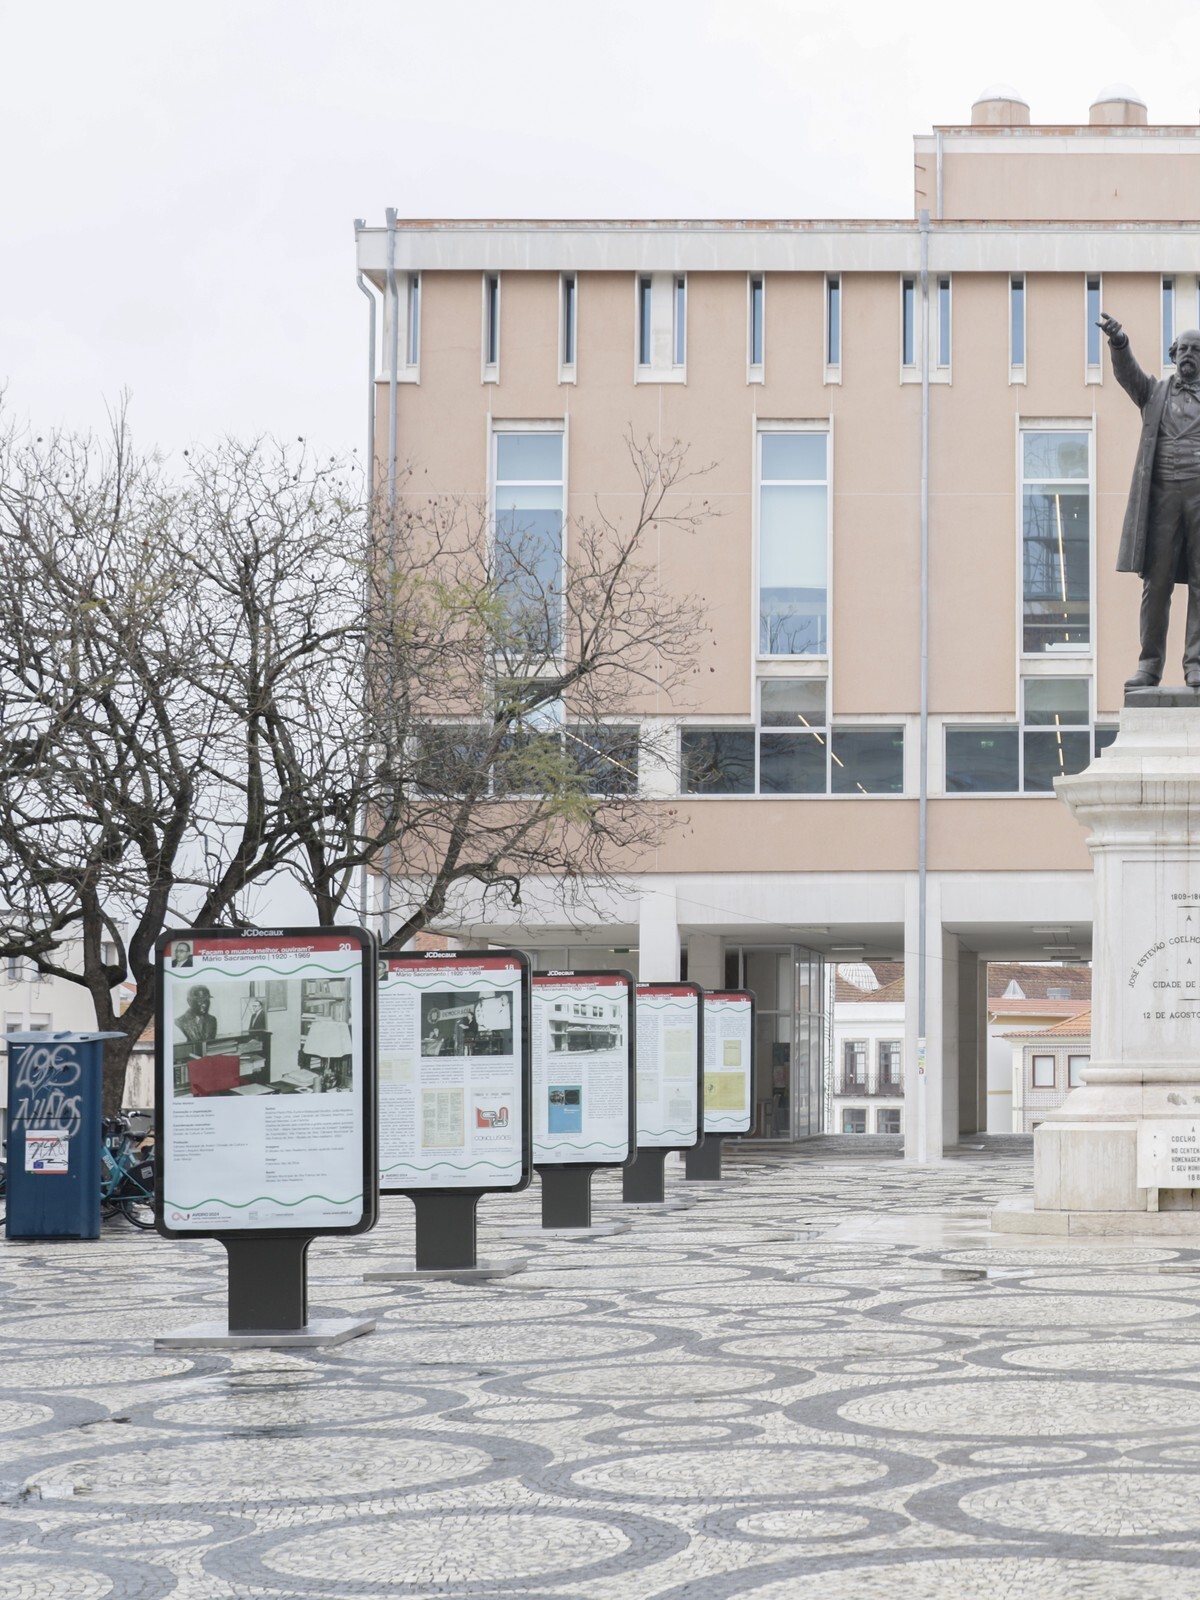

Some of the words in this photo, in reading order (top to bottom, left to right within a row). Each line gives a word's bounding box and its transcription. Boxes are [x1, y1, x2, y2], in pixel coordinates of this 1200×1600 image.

[241, 929, 284, 937] JCDecaux
[339, 943, 351, 951] 20
[1128, 967, 1139, 988] JOSÉ
[1169, 936, 1200, 945] COELHO
